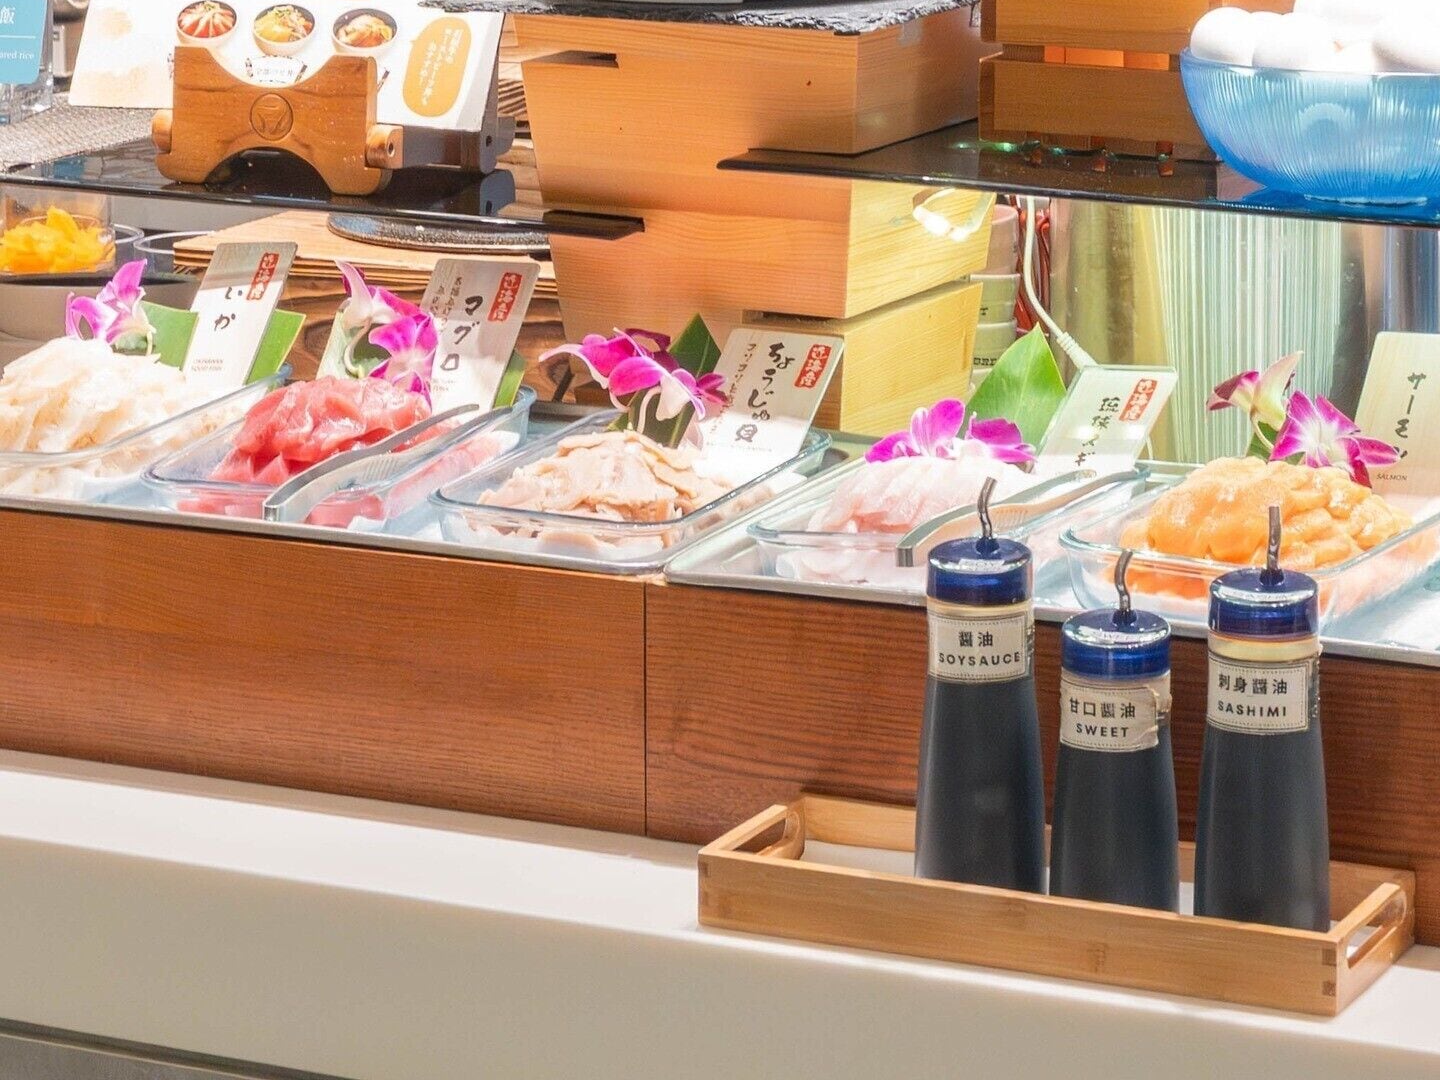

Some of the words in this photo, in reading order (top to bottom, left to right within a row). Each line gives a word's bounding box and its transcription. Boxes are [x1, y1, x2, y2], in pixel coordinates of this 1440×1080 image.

[20, 50, 35, 59] rice
[214, 286, 243, 331] いか
[440, 295, 484, 371] マグロ
[1393, 372, 1427, 460] サーモン
[1376, 472, 1408, 481] SALMON
[938, 652, 1022, 666] SOYSAUCE
[1217, 701, 1288, 717] SASHIMI
[1076, 723, 1129, 738] SWEET
